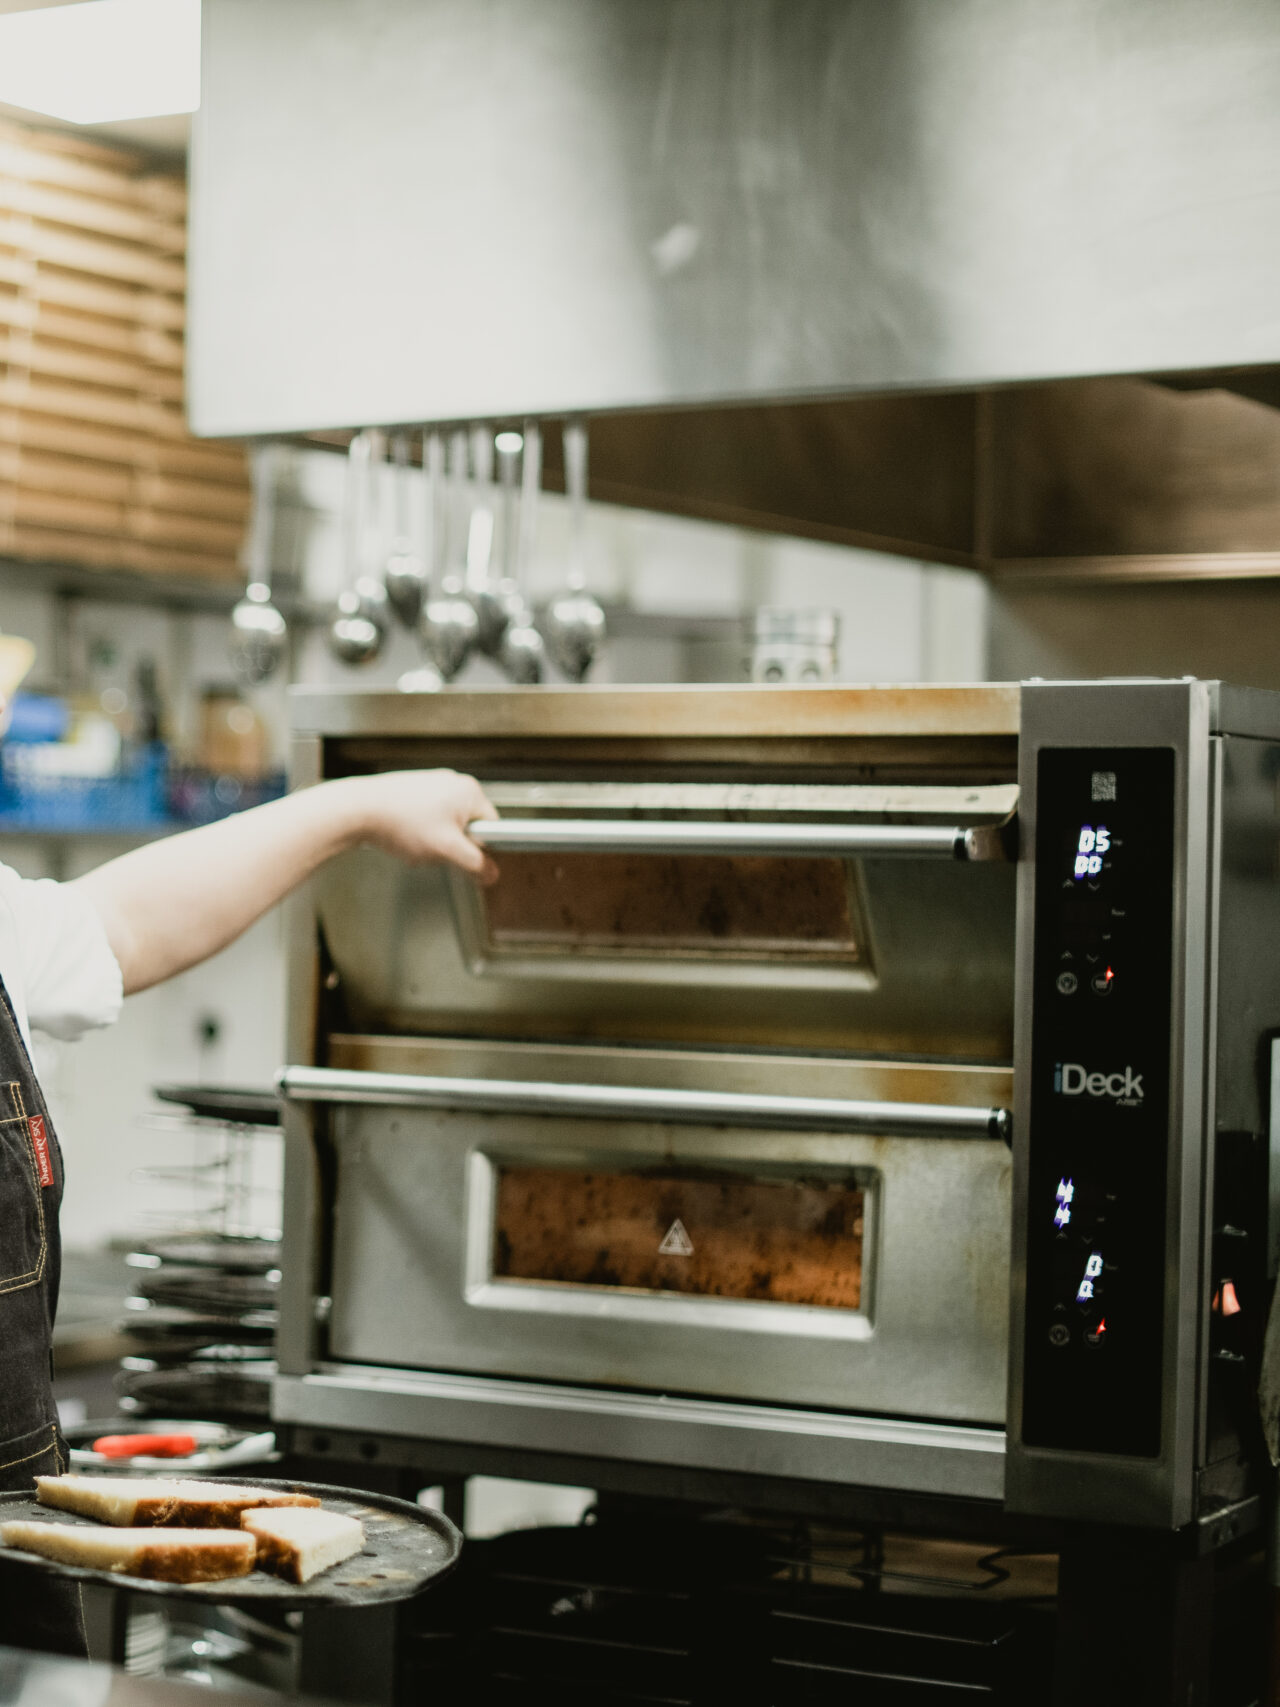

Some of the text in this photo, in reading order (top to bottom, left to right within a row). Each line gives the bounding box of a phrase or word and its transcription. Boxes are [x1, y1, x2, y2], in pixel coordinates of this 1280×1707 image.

[1054, 1062, 1144, 1098] iDeck
[30, 1118, 43, 1137] SKY
[39, 1152, 50, 1184] UNDER
